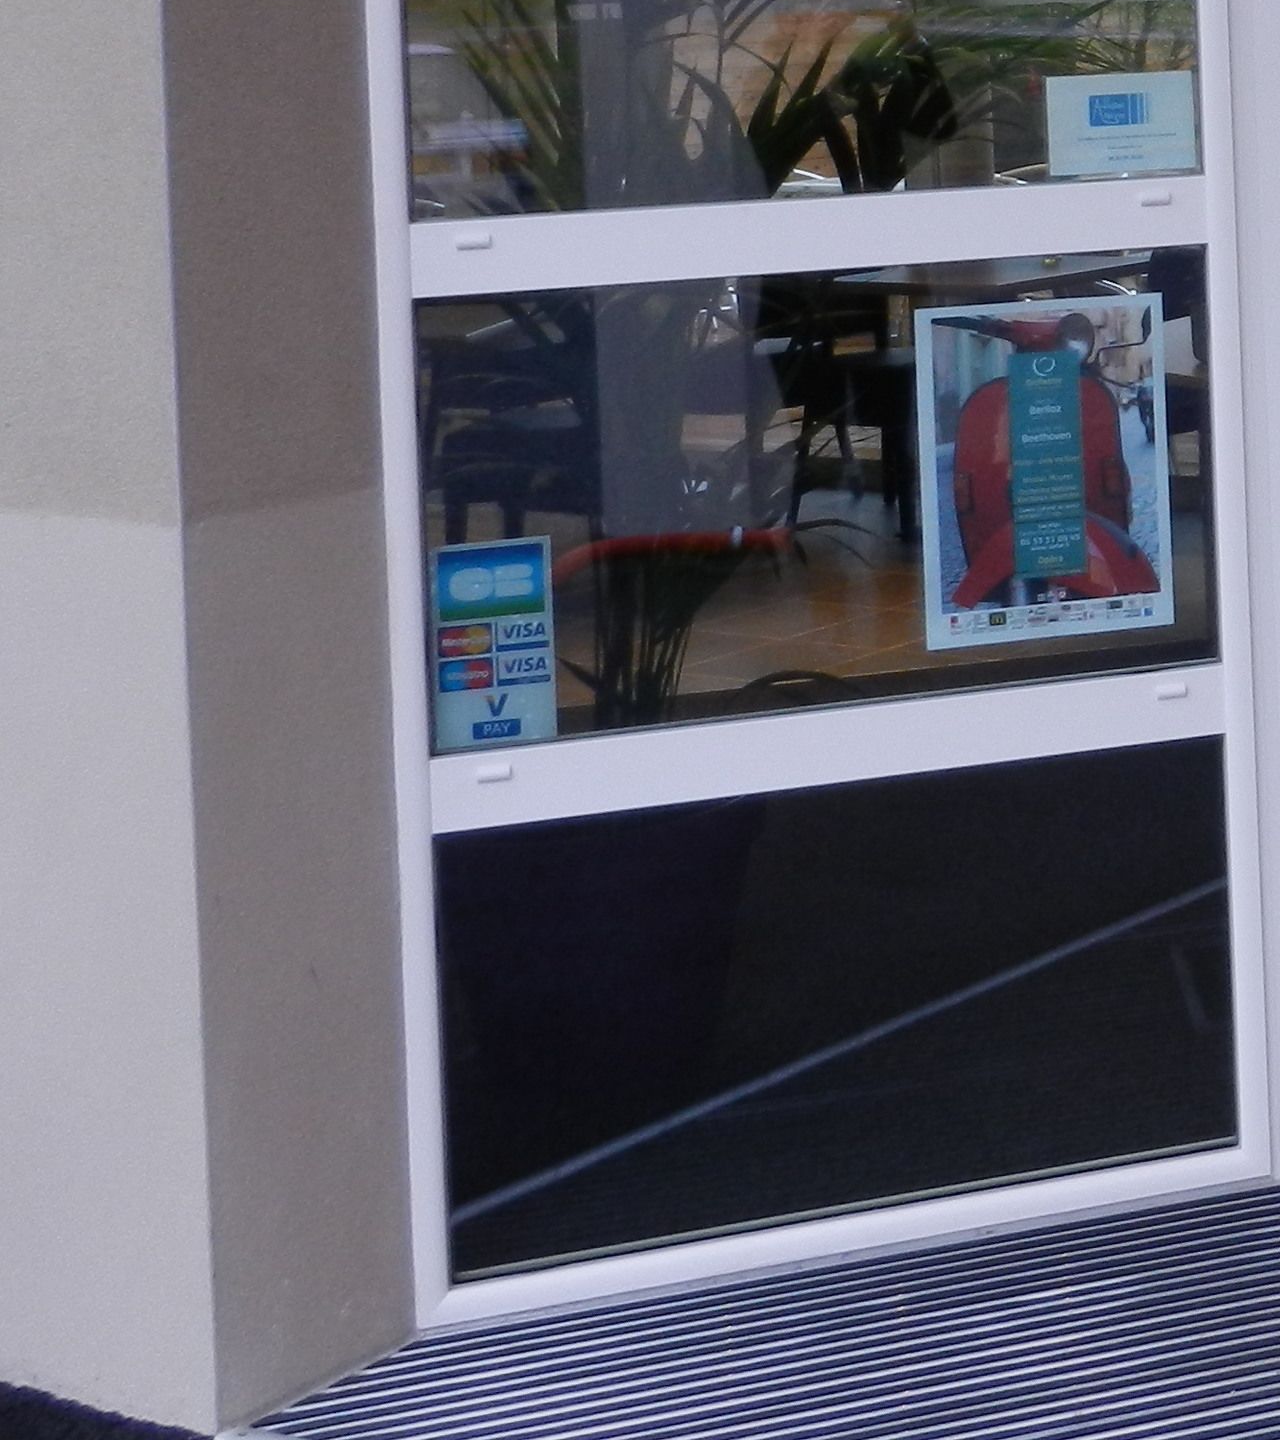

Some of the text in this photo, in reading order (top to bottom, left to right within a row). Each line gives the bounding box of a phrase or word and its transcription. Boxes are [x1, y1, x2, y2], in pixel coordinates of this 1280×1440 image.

[1028, 404, 1062, 416] Berlioz
[1021, 430, 1072, 444] Beethoven
[503, 622, 546, 639] VISA
[504, 656, 547, 674] VISA
[485, 693, 508, 717] V
[483, 723, 511, 736] PAY
